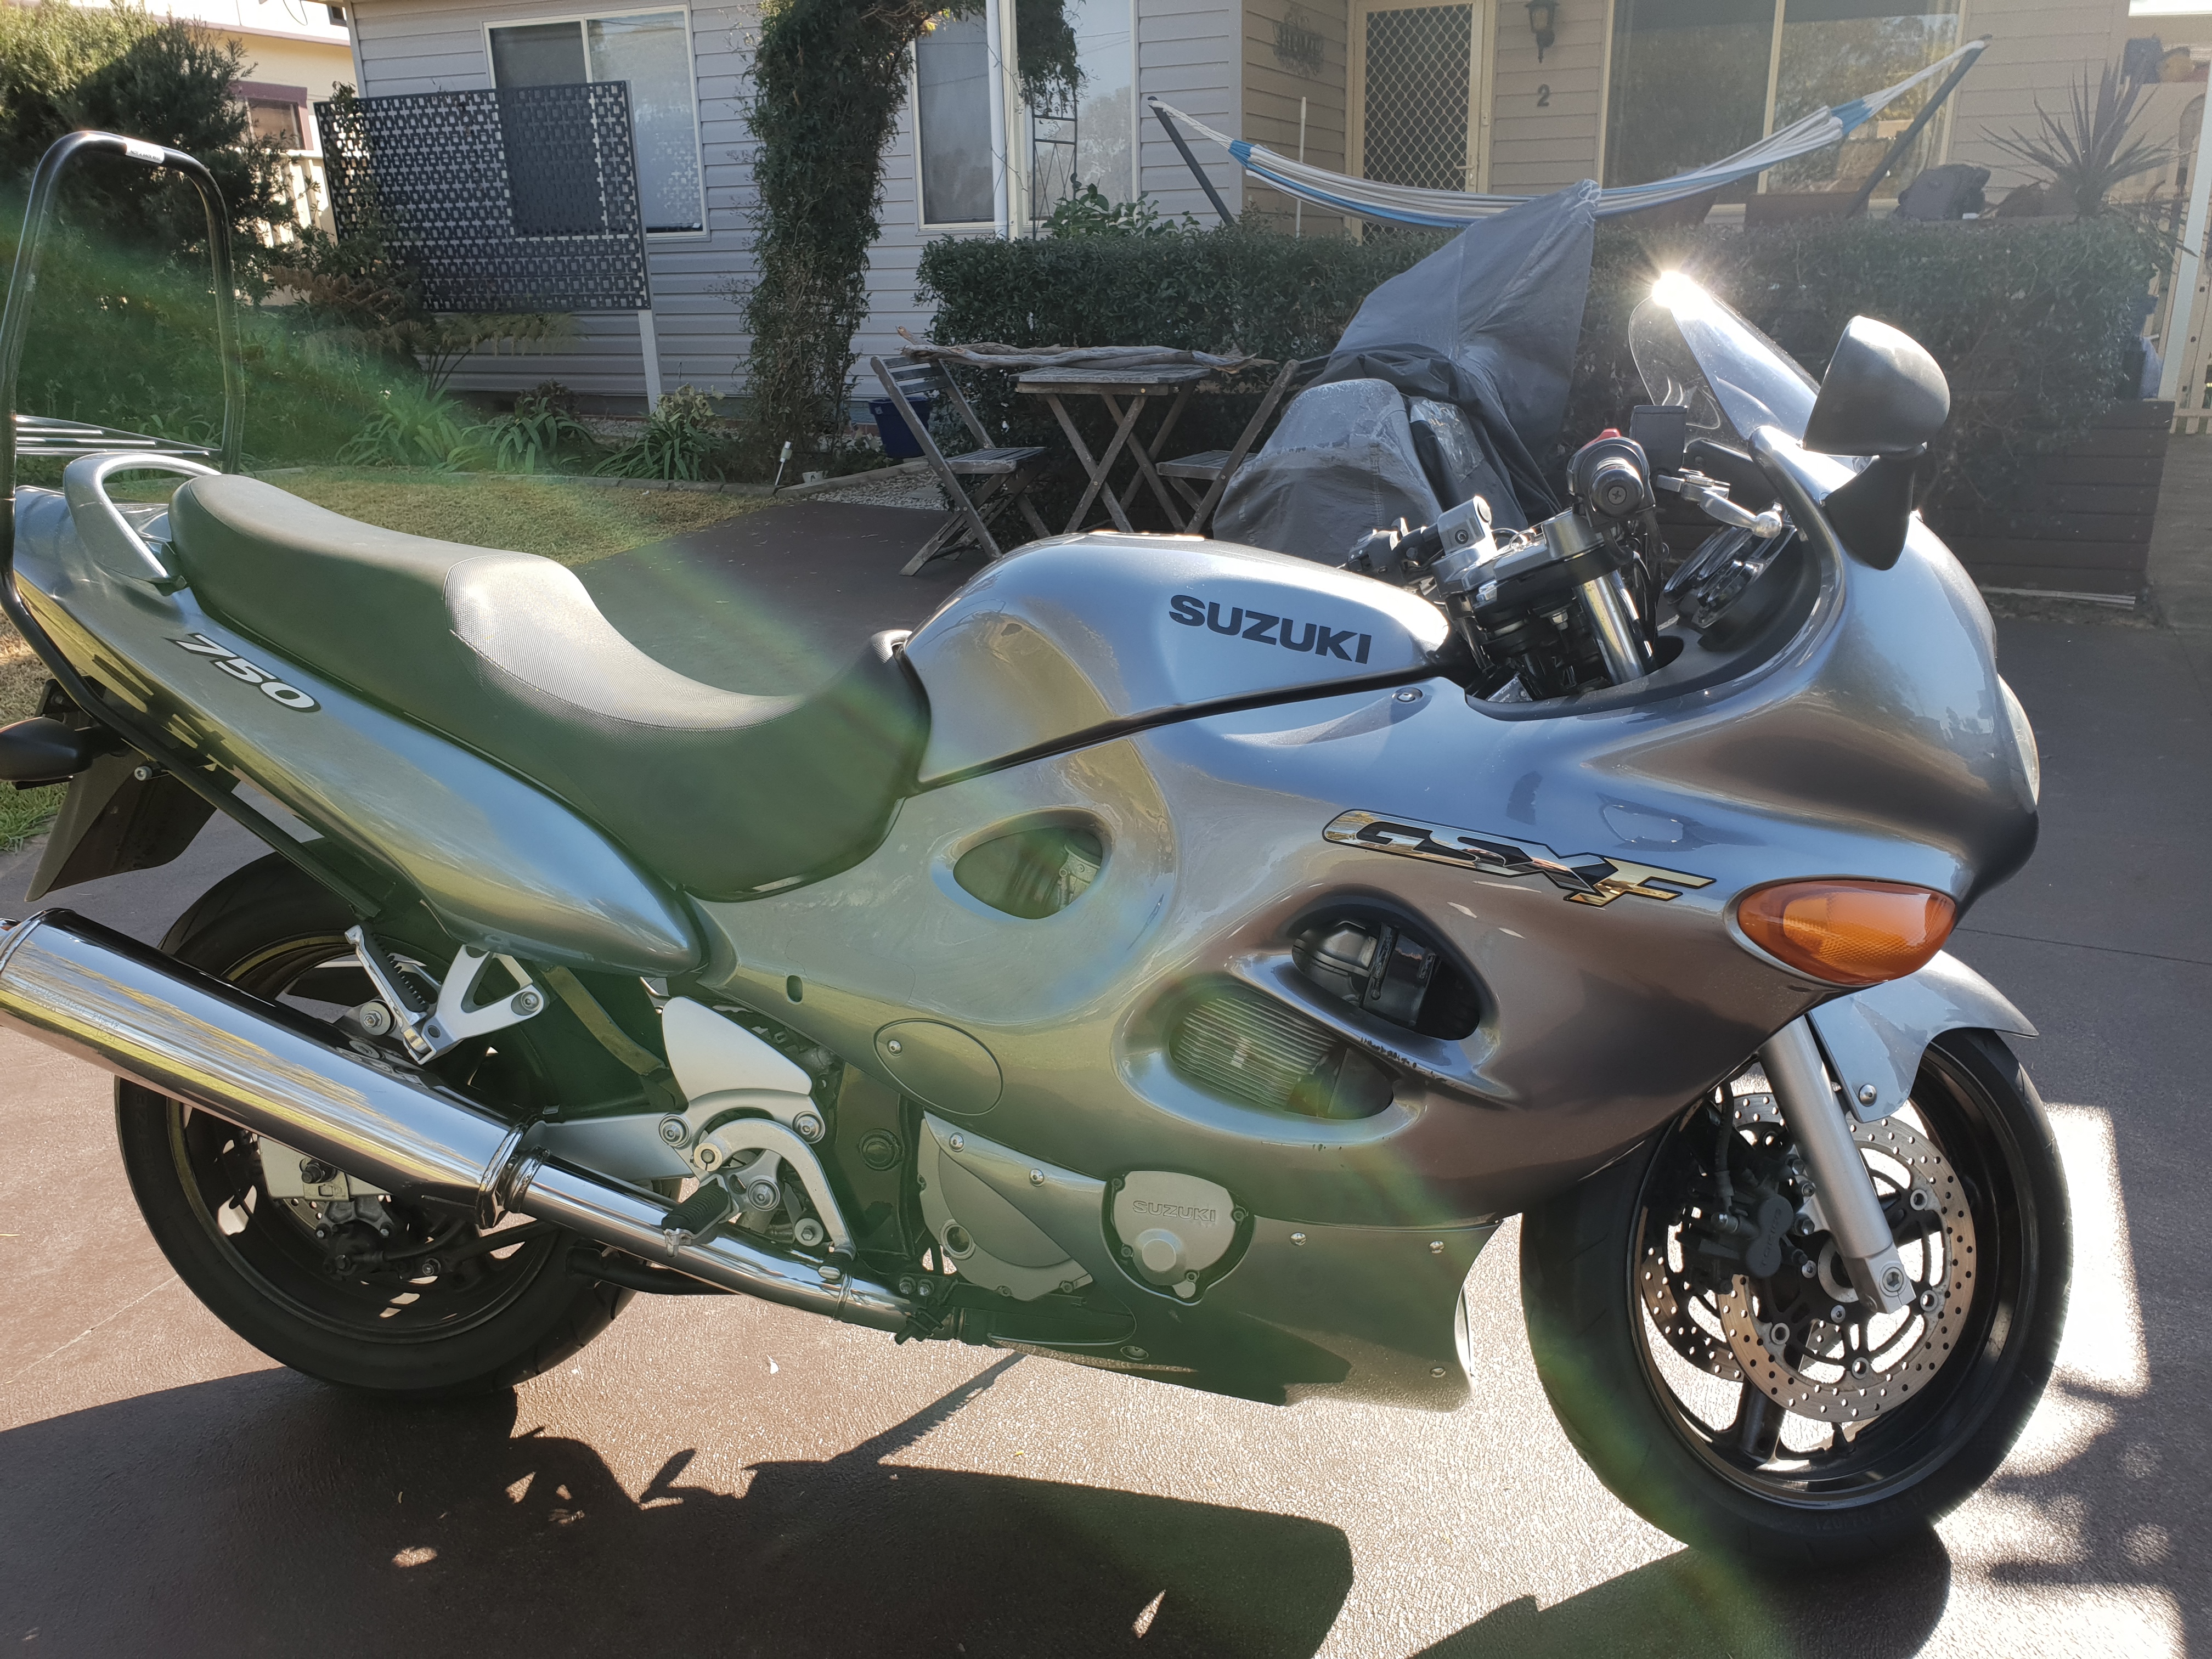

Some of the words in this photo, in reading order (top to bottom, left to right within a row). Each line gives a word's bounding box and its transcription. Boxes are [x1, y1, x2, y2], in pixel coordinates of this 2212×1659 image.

[1537, 84, 1550, 107] 2
[1169, 595, 1372, 664] SUZUKI
[161, 633, 321, 713] 750
[1132, 1200, 1216, 1222] SUZUKI
